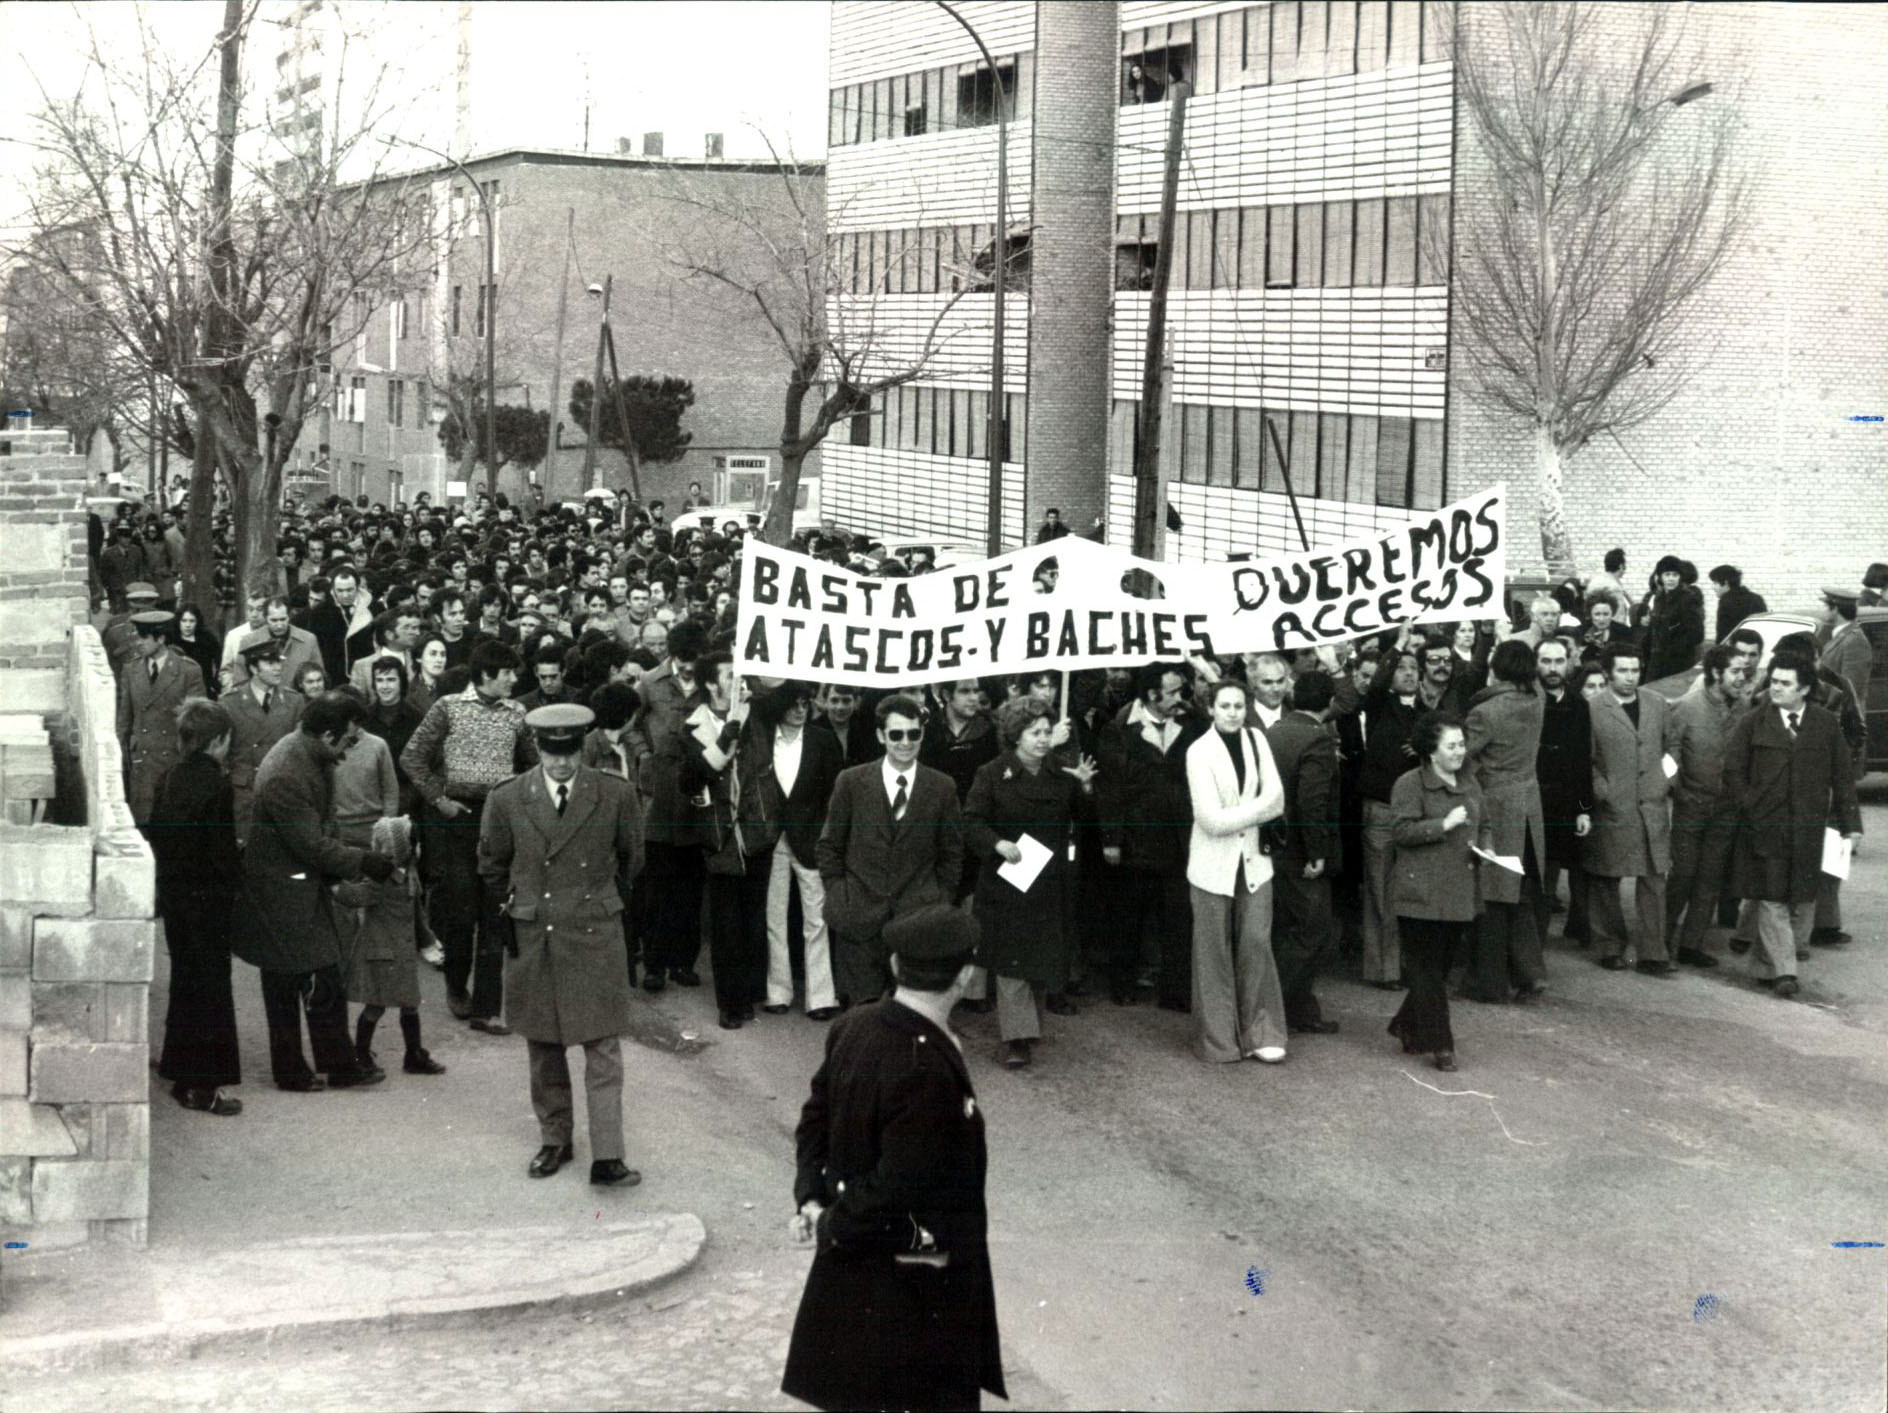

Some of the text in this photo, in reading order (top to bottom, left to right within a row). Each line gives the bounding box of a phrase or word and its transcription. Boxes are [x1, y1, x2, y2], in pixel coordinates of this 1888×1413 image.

[753, 555, 1013, 618] BASTA DE
[1233, 497, 1499, 615] QUEREMOS
[1025, 609, 1214, 660] BACHES
[1272, 558, 1494, 650] ACCESOS
